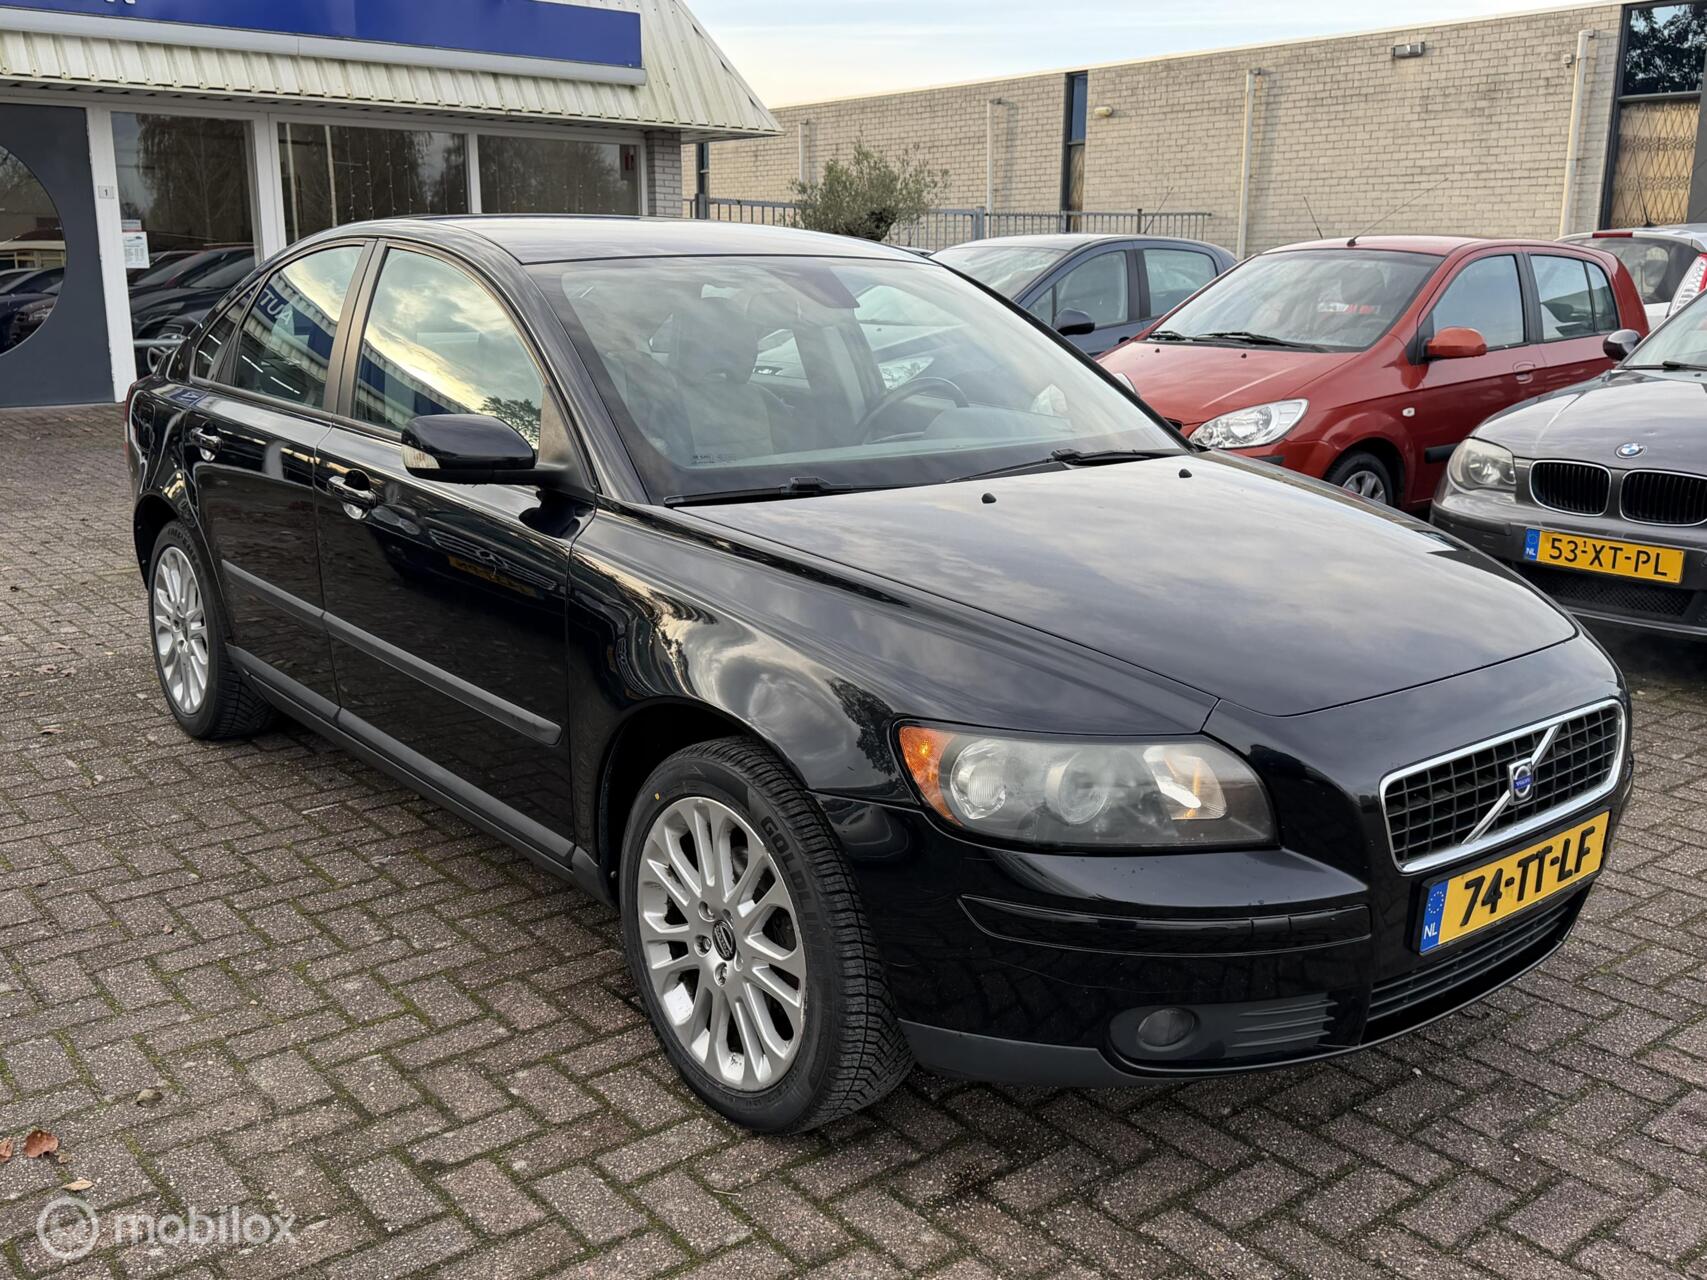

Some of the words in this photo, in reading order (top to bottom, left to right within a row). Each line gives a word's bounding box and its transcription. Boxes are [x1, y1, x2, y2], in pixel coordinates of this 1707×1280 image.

[1525, 547, 1536, 556] NL
[1549, 537, 1668, 577] 53-XT-PL
[1459, 825, 1596, 928] 74-TT-LF
[1423, 921, 1438, 940] NL
